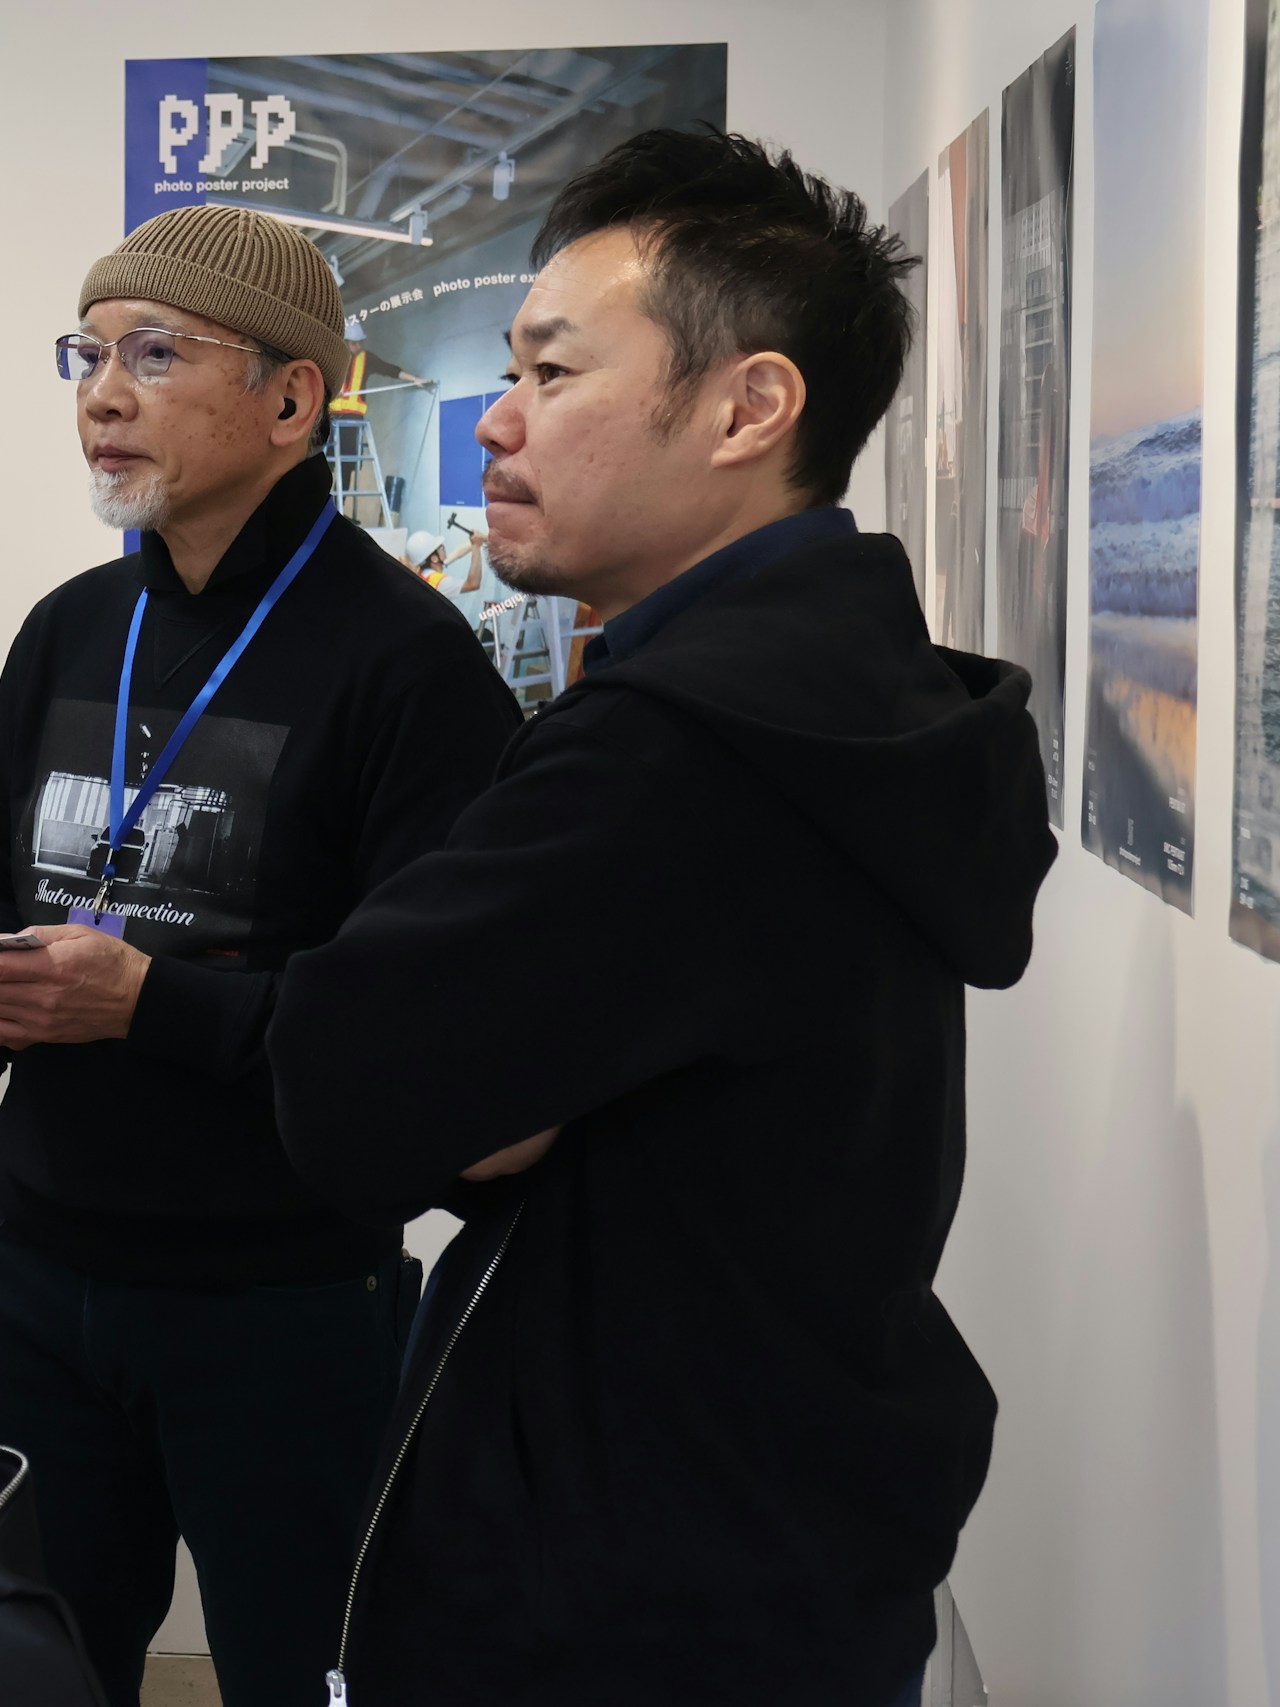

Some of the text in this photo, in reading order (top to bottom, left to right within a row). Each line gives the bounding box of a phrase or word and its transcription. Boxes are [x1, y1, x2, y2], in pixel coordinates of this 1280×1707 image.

[155, 177, 289, 194] photo poster project
[432, 278, 471, 297] photo
[474, 272, 516, 288] poster
[107, 902, 198, 926] connection
